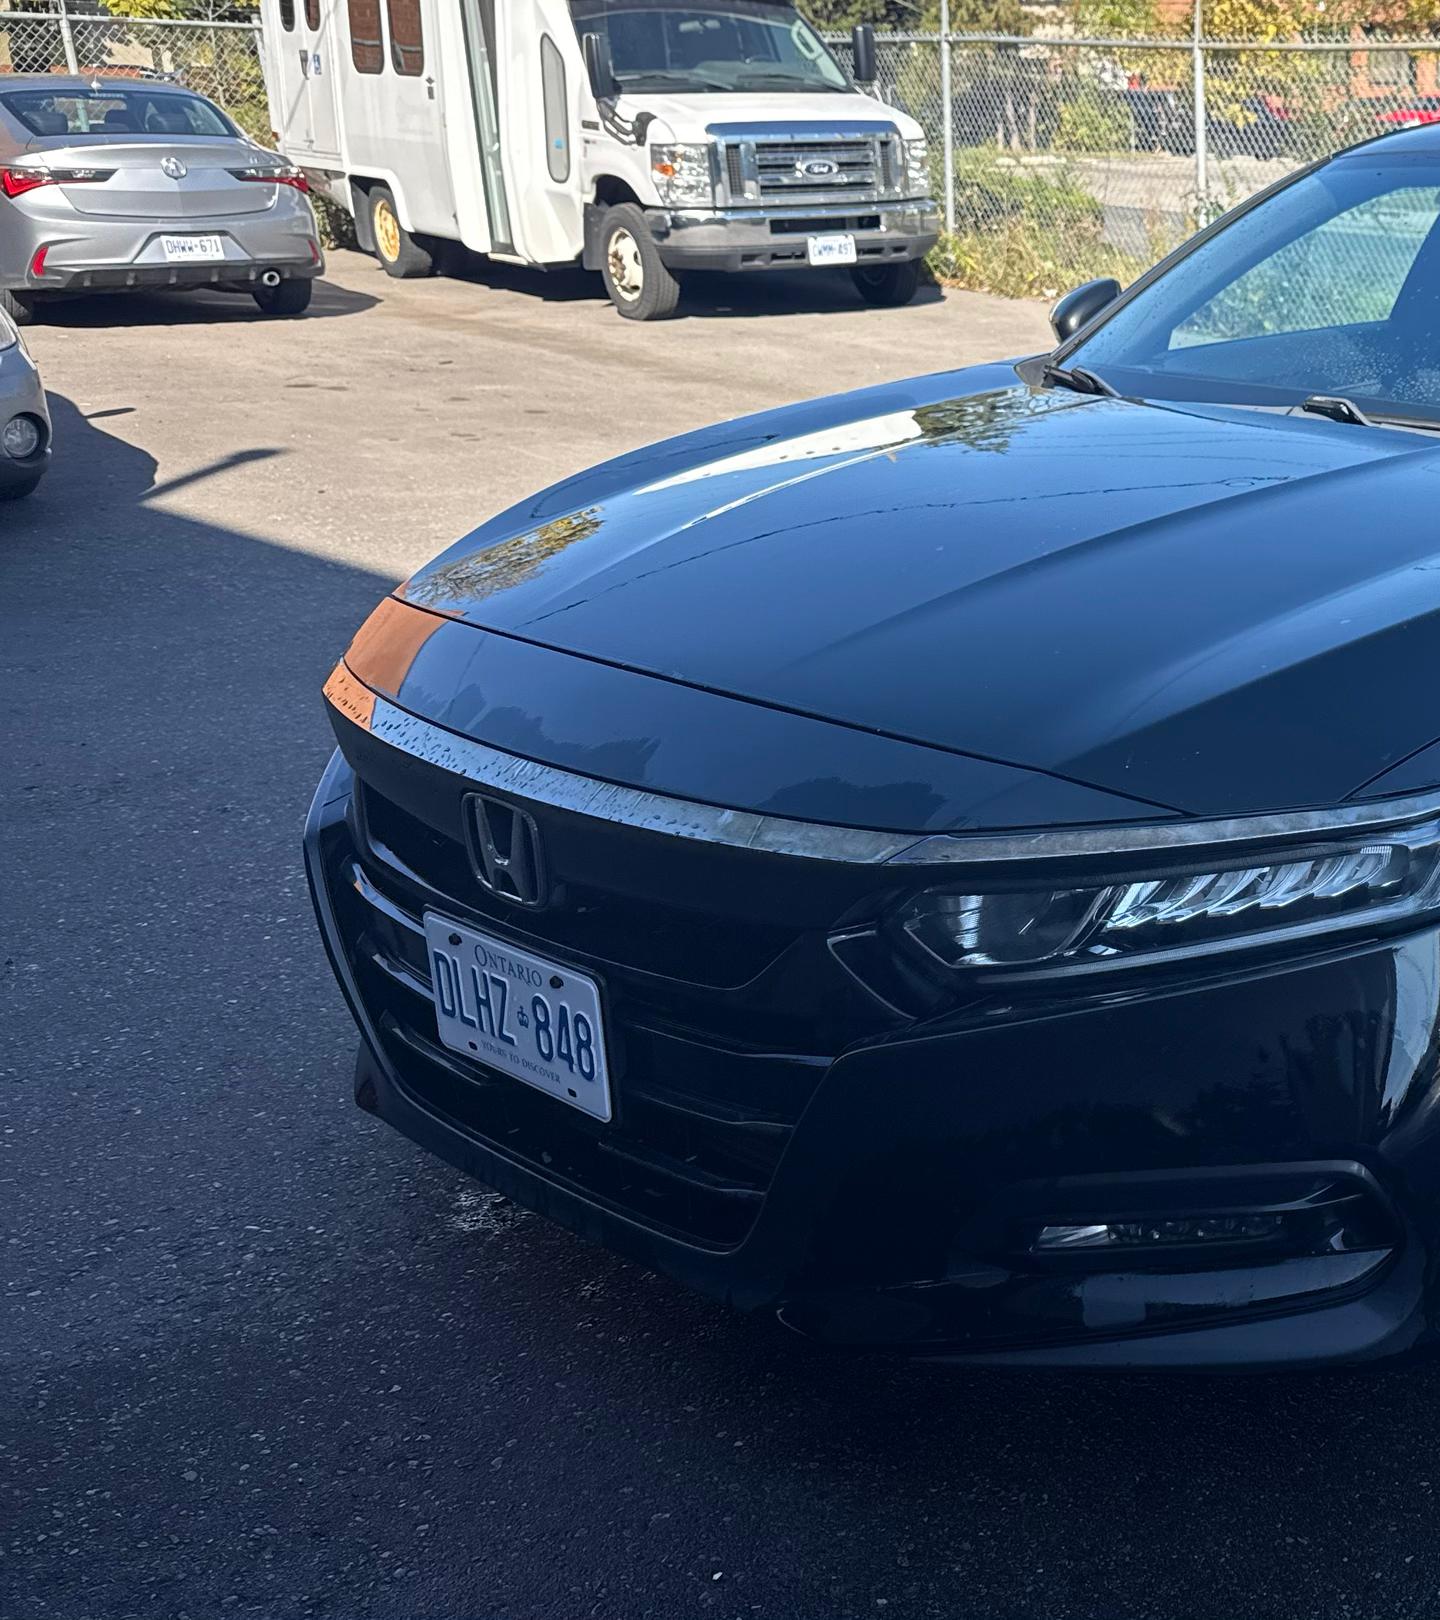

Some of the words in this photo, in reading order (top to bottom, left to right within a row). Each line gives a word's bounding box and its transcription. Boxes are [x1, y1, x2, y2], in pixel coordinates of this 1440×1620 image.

[199, 239, 220, 253] 671
[474, 944, 542, 987] ONTARIO
[434, 949, 517, 1046] DLHZ
[532, 994, 595, 1081] 848
[510, 1054, 520, 1064] TO
[522, 1058, 561, 1084] DISCOVER
